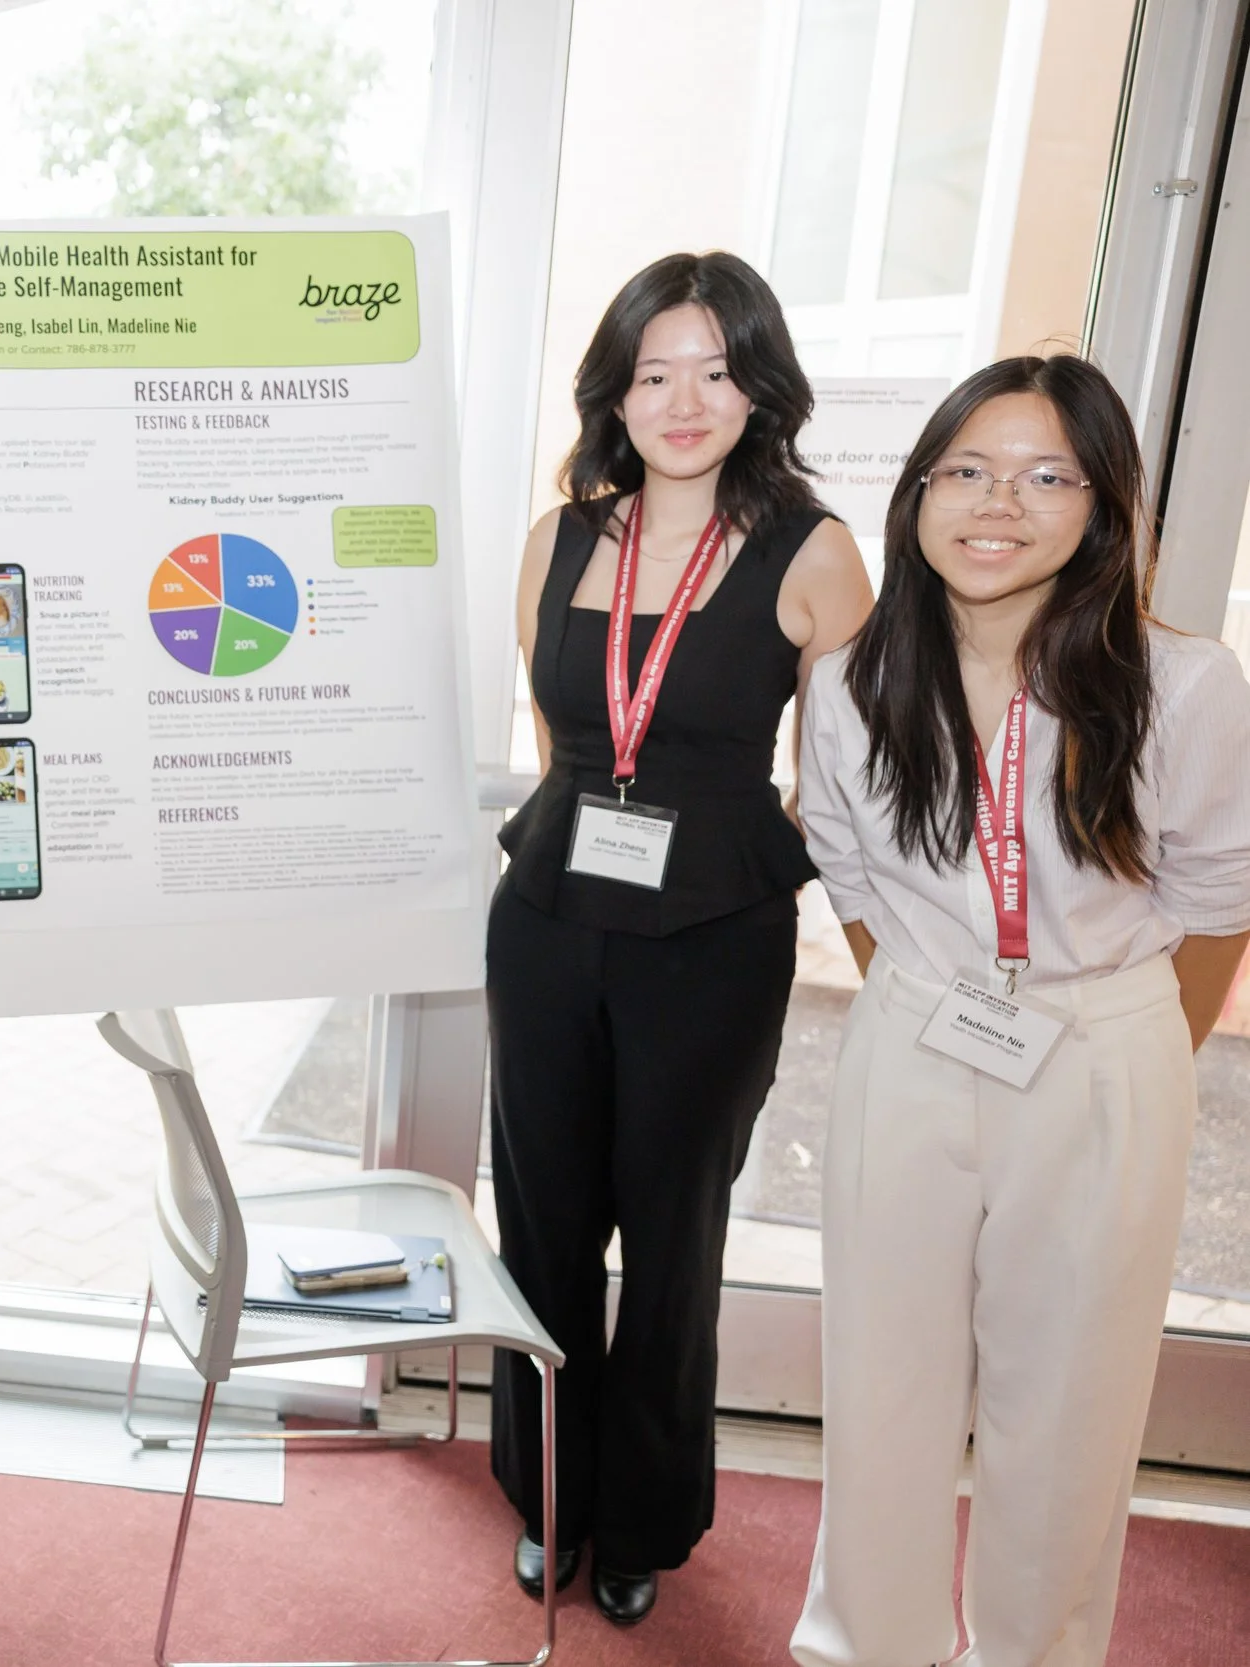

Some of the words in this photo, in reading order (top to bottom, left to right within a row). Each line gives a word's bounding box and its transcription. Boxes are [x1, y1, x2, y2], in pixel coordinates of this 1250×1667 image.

[67, 245, 129, 266] Health
[137, 246, 224, 266] Assistant
[231, 246, 257, 266] for
[15, 276, 183, 301] Self-Management
[299, 275, 401, 321] braze
[32, 318, 72, 334] Isabel
[79, 318, 102, 334] Lin,
[108, 318, 169, 333] Madeline
[175, 318, 196, 333] Nie
[135, 381, 232, 401] RESEARCH
[241, 380, 253, 400] &
[261, 378, 349, 400] ANALYSIS
[135, 415, 186, 430] TESTING
[192, 415, 200, 429] &
[206, 414, 270, 429] FEEDBACK
[837, 450, 874, 463] door
[169, 496, 206, 506] Kidney
[211, 496, 245, 505] Buddy
[249, 495, 273, 503] User
[278, 494, 343, 504] Suggestions
[189, 554, 208, 564] 13%
[33, 576, 84, 587] NUTRITION
[164, 583, 183, 593] 13%
[247, 574, 275, 587] 33%
[34, 590, 82, 601] TRACKING
[175, 630, 198, 640] 20%
[234, 640, 257, 650] 20%
[148, 688, 240, 705] CONCLUSIONS
[245, 688, 253, 702] &
[259, 686, 306, 701] FUTURE
[312, 684, 350, 699] WORK
[1007, 703, 1022, 761] Coding
[43, 754, 69, 765] MEAL
[72, 753, 102, 764] PLANS
[153, 750, 292, 769] ACKNOWLEDGEMENTS
[1003, 764, 1017, 836] Inventor
[159, 806, 239, 823] REFERENCES
[1003, 839, 1021, 872] App
[1004, 875, 1018, 911] MIT
[956, 1013, 1005, 1040] Madeline
[1006, 1036, 1025, 1050] Nie
